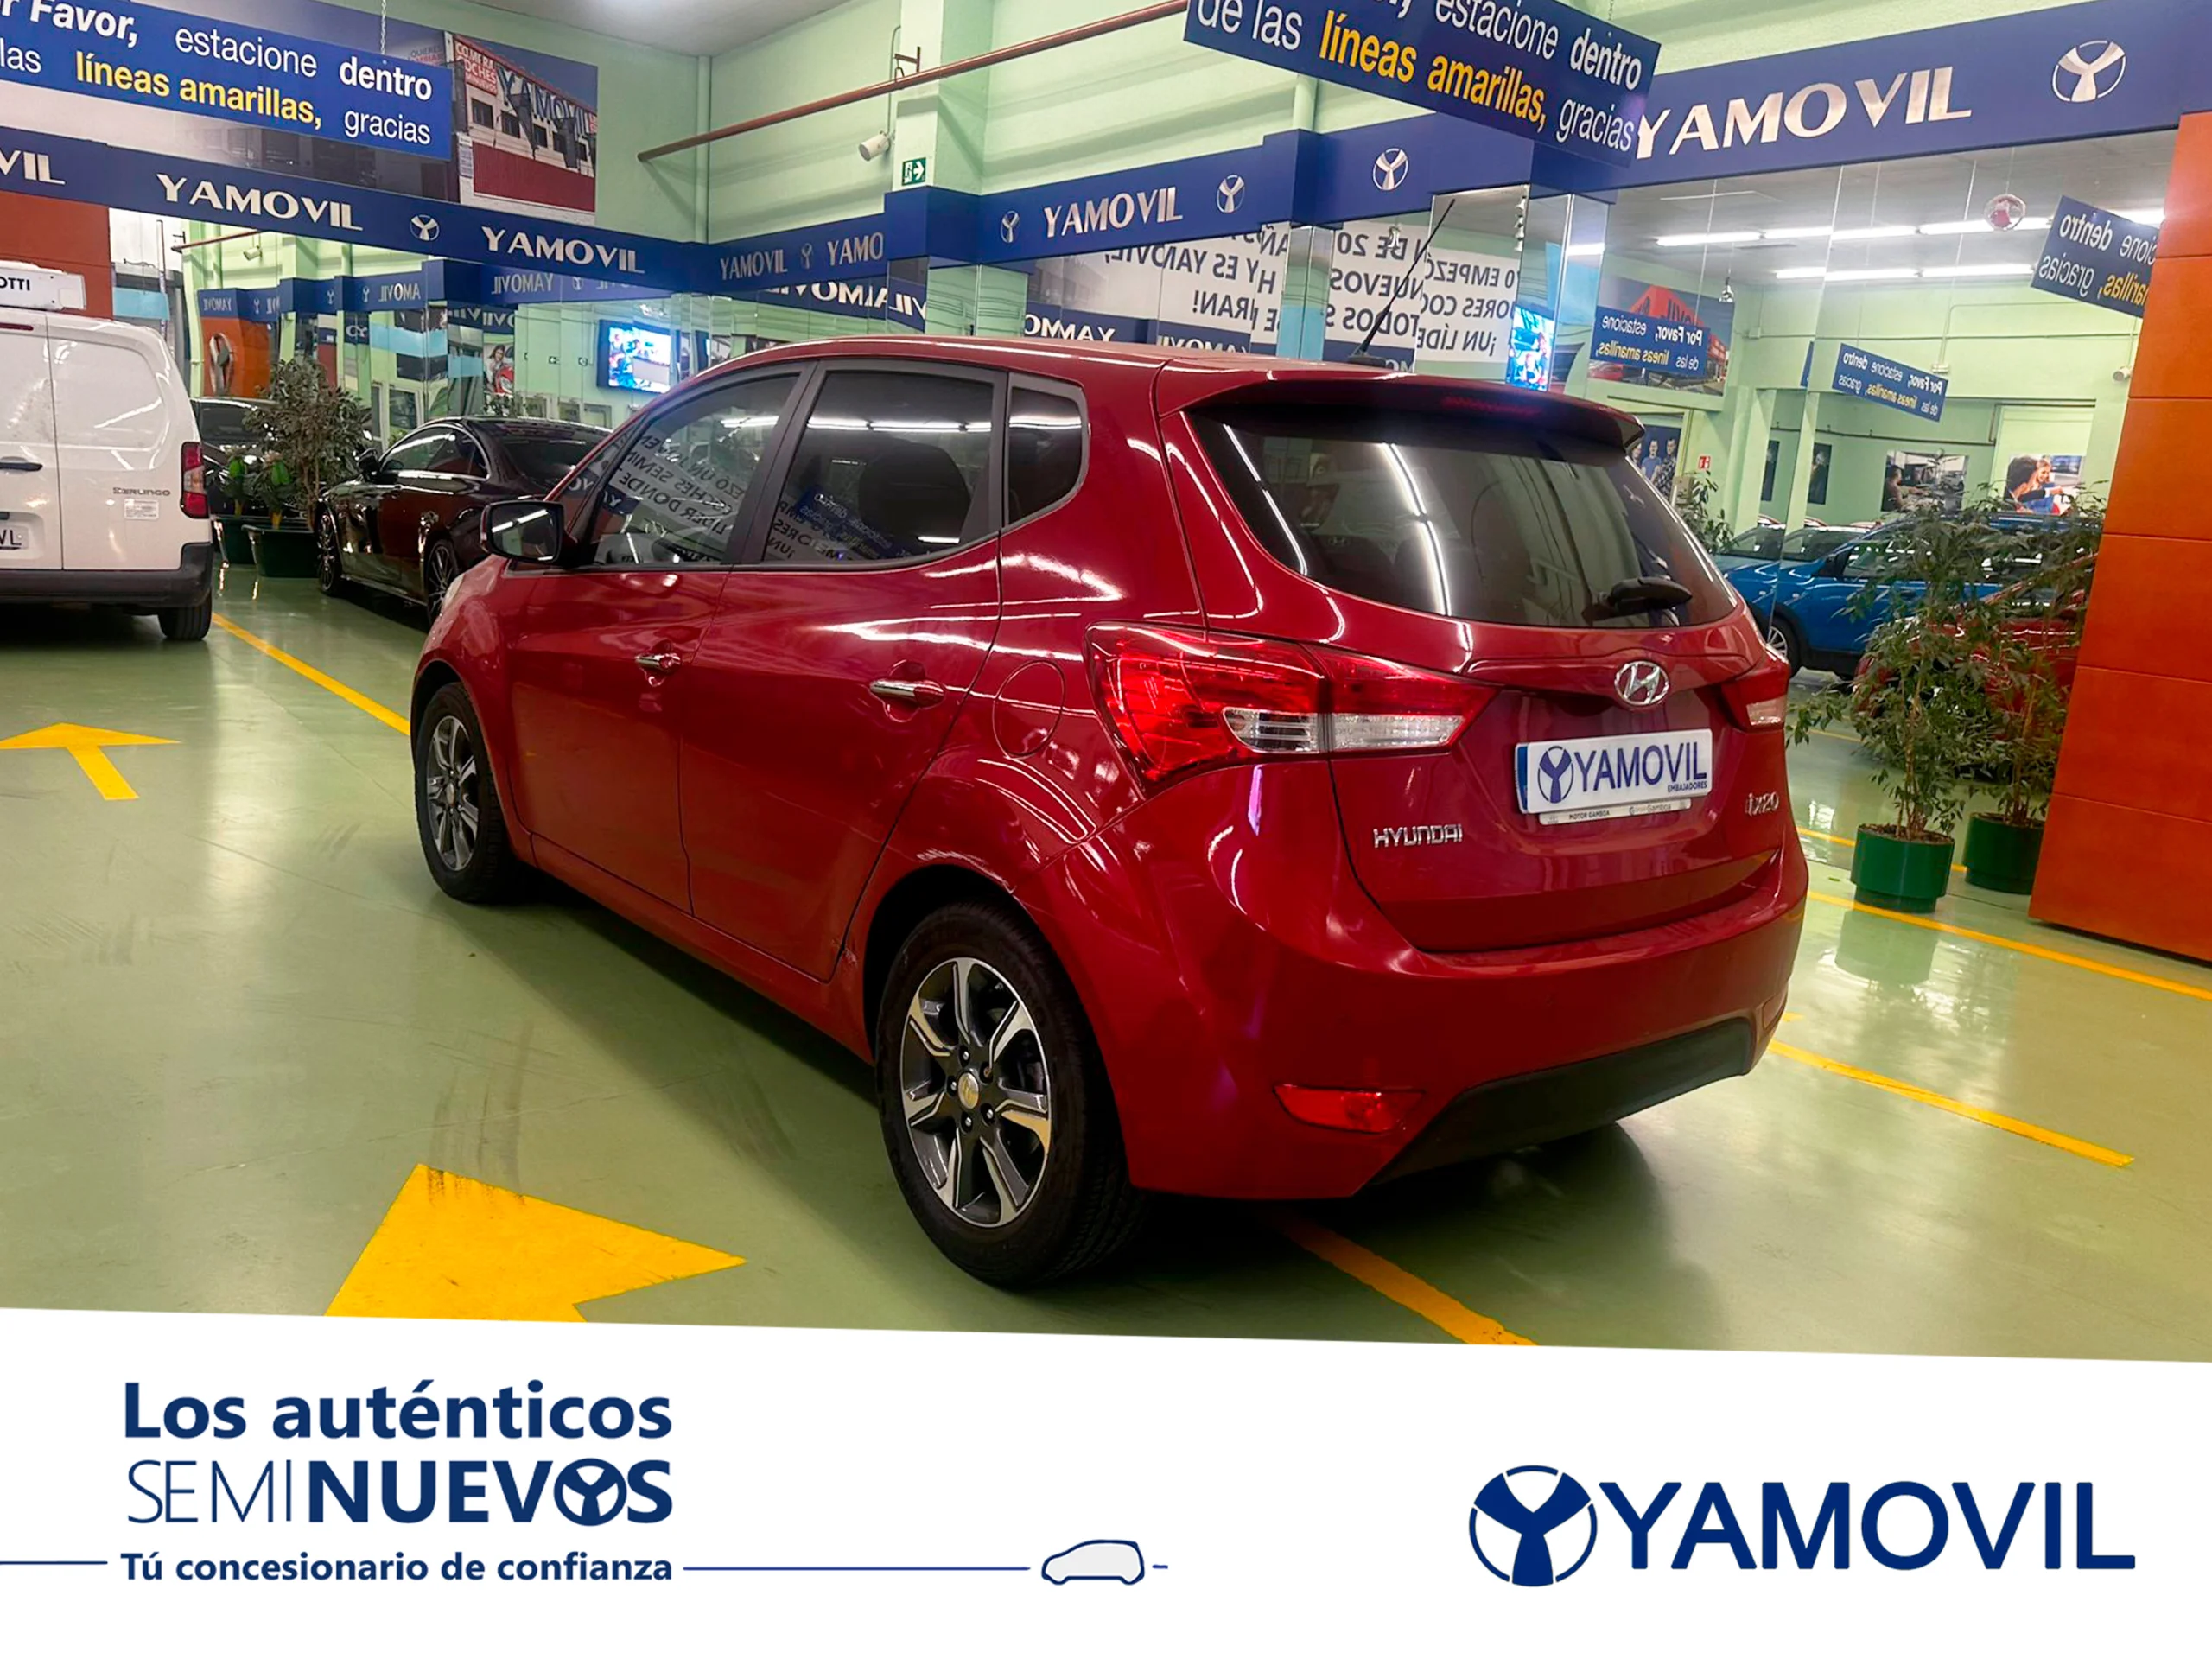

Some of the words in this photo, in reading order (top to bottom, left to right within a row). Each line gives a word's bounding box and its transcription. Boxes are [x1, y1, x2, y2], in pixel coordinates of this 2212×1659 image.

[30, 0, 137, 48] Favor,
[175, 27, 317, 78] estacione
[339, 56, 432, 101] dentro
[1252, 0, 1302, 50] las
[1319, 10, 1417, 84] líneas
[1427, 53, 1548, 134] amarillas,
[1556, 96, 1636, 153] gracias
[1435, 0, 1559, 60] estacione
[1570, 25, 1642, 92] dentro
[0, 37, 41, 73] las
[76, 51, 170, 97] líneas
[179, 77, 321, 130] amarillas,
[345, 109, 431, 144] gracias
[1636, 66, 1972, 161] YAMOVIL
[156, 173, 364, 232] YAMOVIL
[480, 226, 645, 274] YAMOVIL
[1044, 186, 1183, 238] YAMOVIL
[720, 249, 788, 280] YAMOVIL
[827, 232, 884, 266] YAMO
[1573, 741, 1707, 793] YAMOVIL
[1667, 780, 1708, 794] EMBAJADORES
[1373, 823, 1464, 849] HYUNDAI
[1568, 812, 1588, 821] MOTOR
[1588, 810, 1611, 820] GAMBOA
